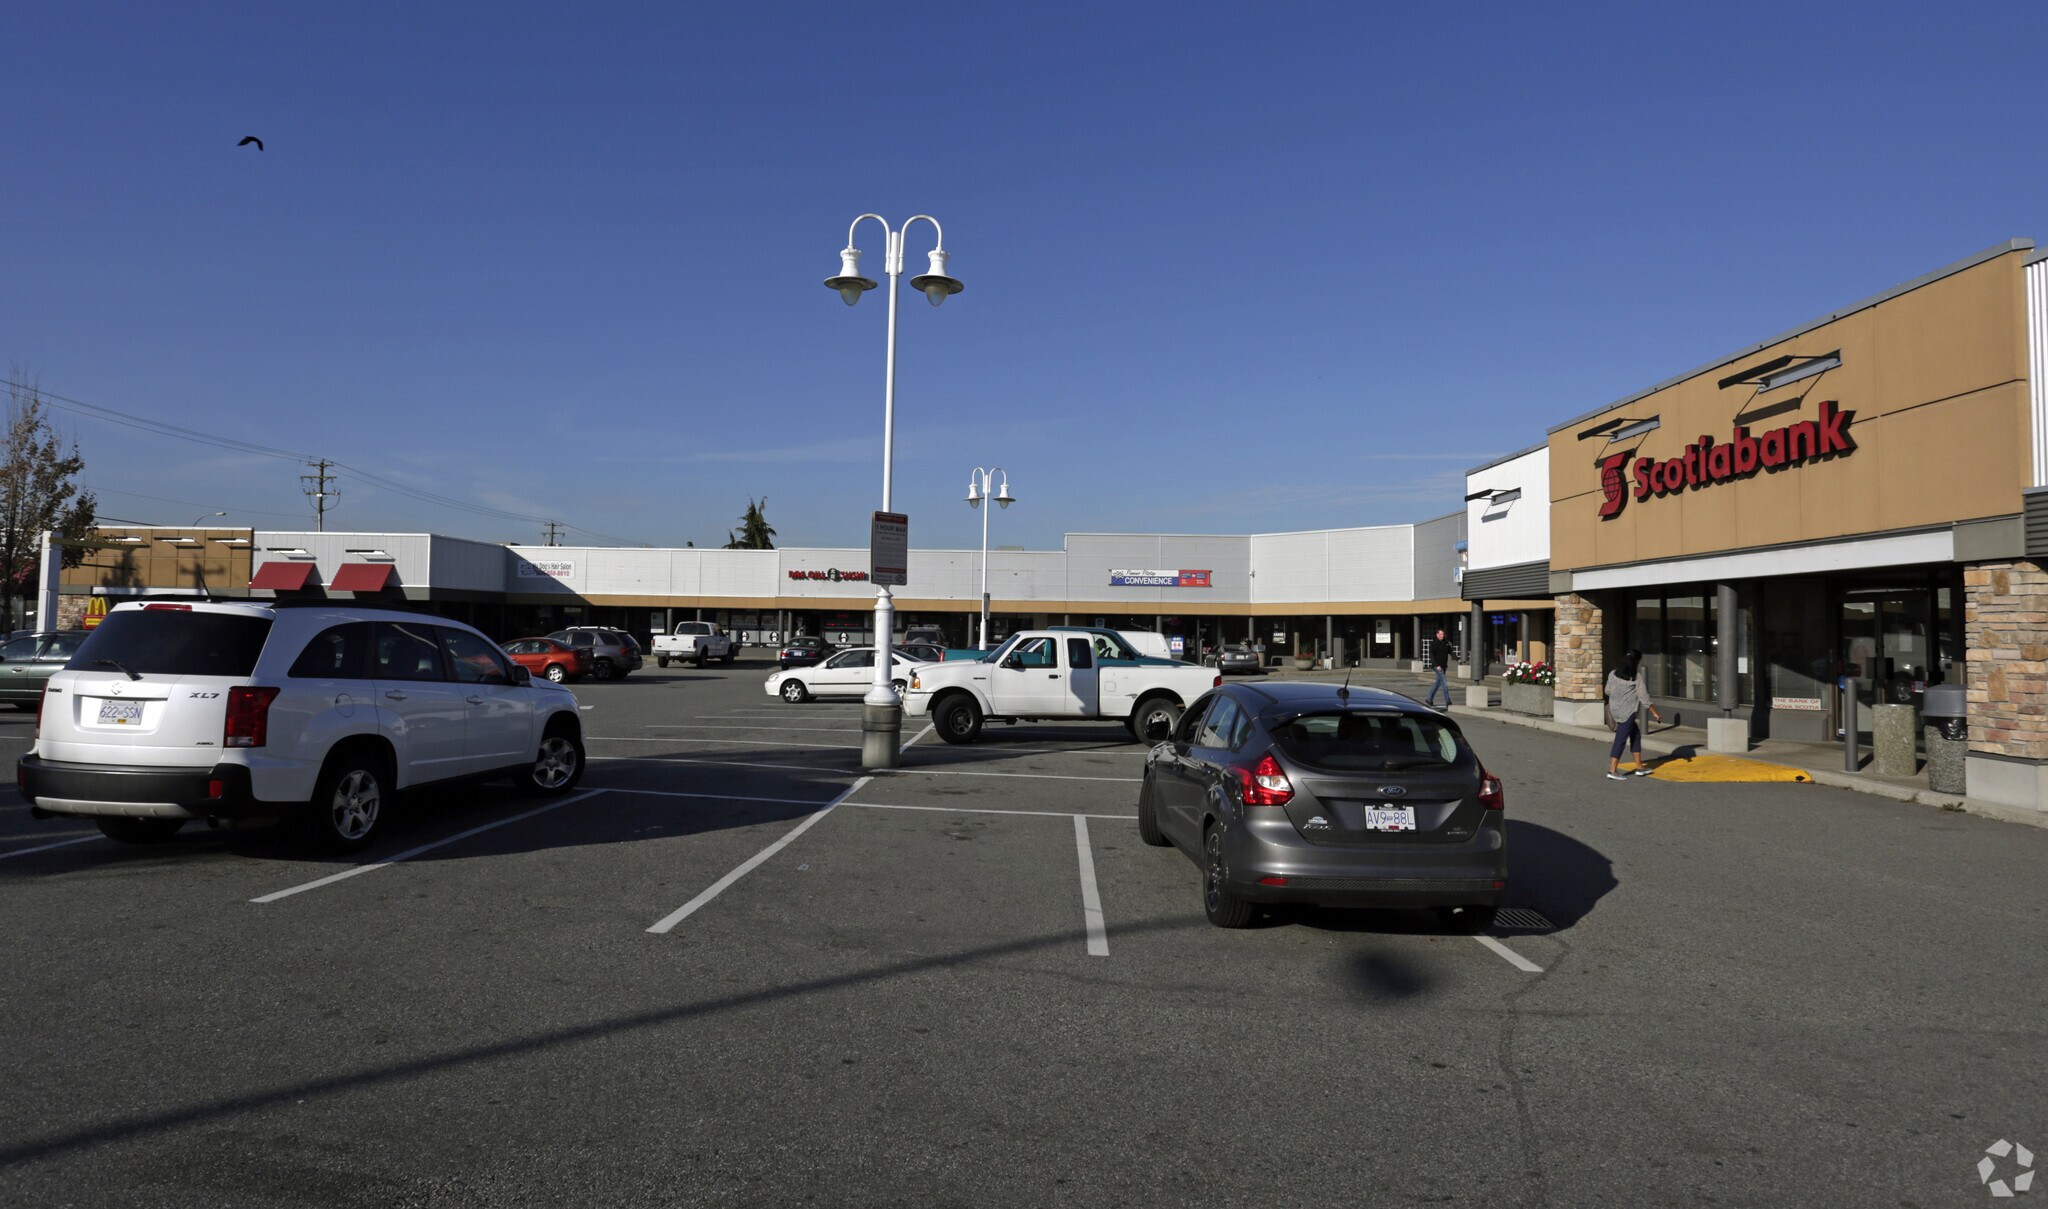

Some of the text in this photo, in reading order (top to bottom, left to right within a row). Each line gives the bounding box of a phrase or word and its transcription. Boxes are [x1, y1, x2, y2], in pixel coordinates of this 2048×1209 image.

[1633, 400, 1855, 498] Scotiabank
[540, 562, 550, 571] Dog's
[551, 562, 559, 570] Hair
[561, 562, 572, 570] Salon
[1124, 576, 1173, 585] CONVENIENCE
